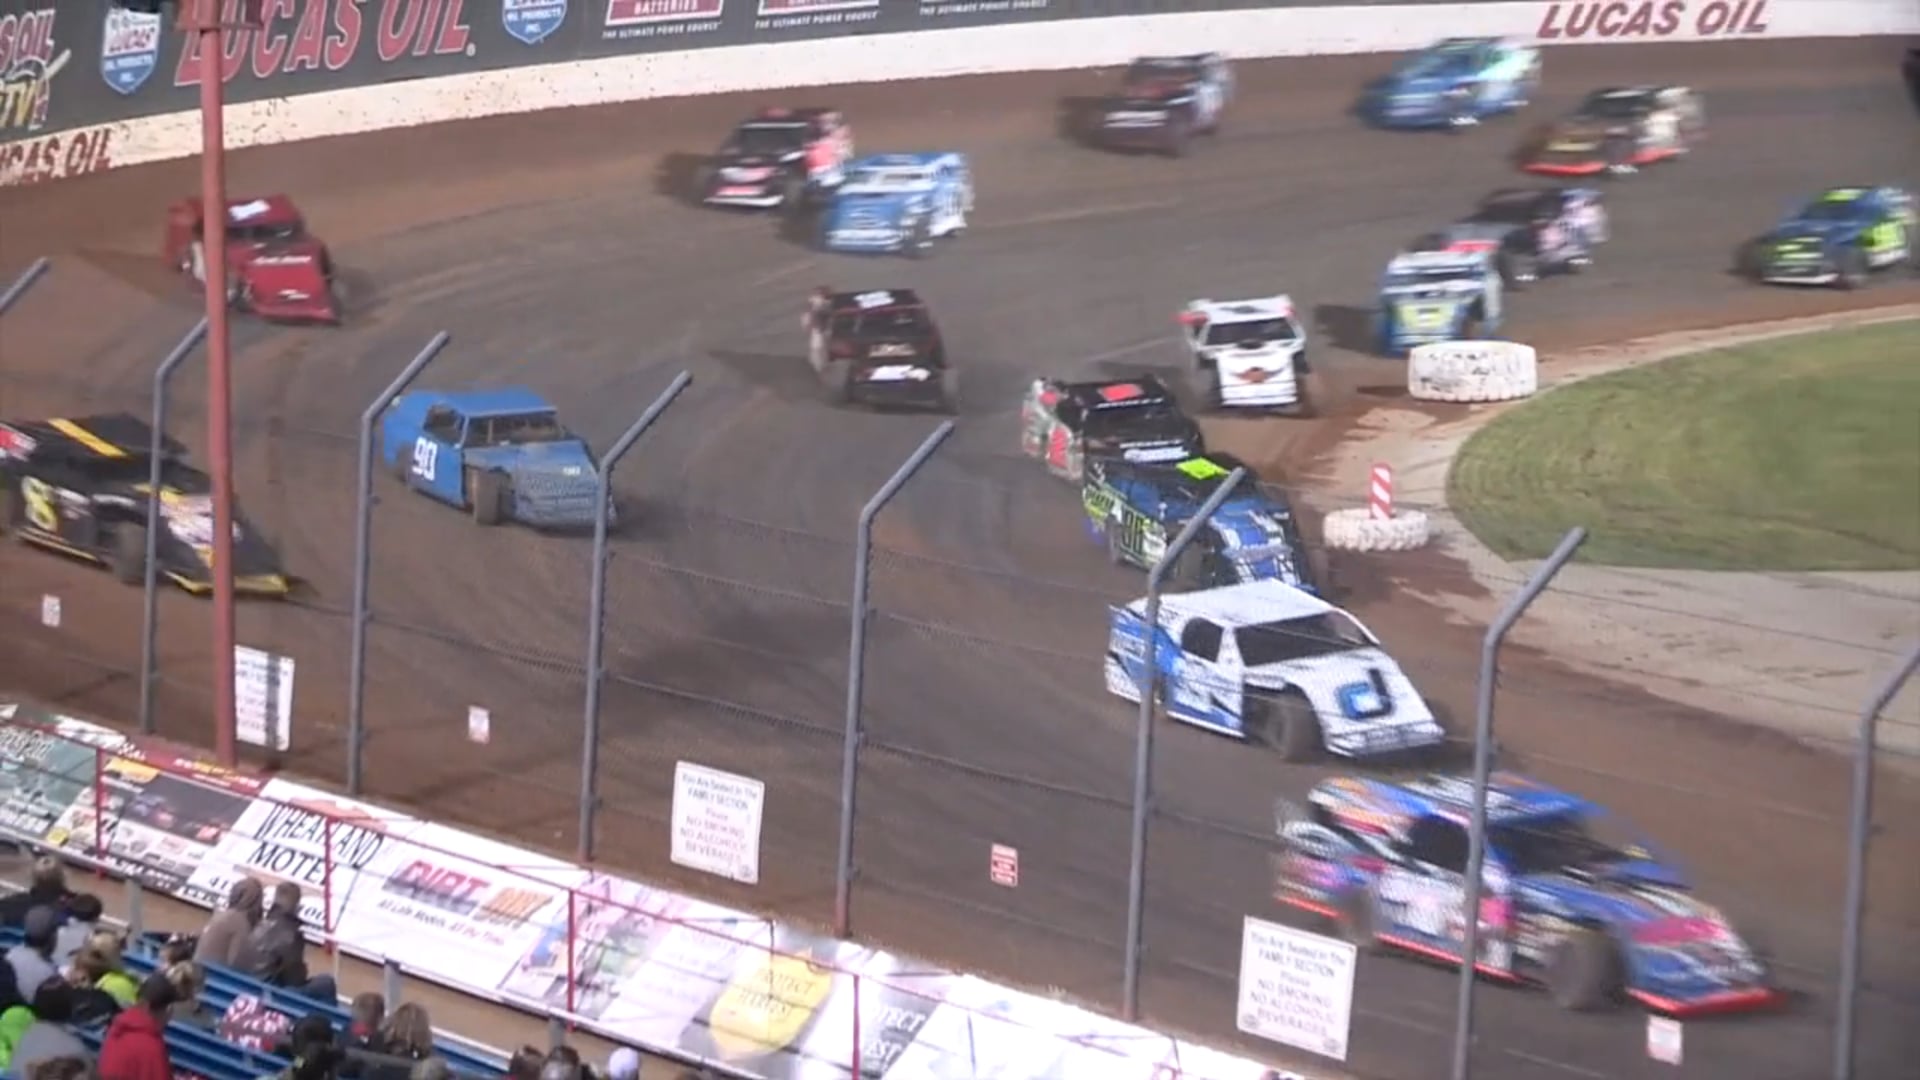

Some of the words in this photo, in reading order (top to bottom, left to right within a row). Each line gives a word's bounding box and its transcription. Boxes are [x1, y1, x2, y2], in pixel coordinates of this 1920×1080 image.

[1536, 0, 1686, 38] LUCAS
[1696, 0, 1769, 36] OIL
[412, 436, 438, 481] 90
